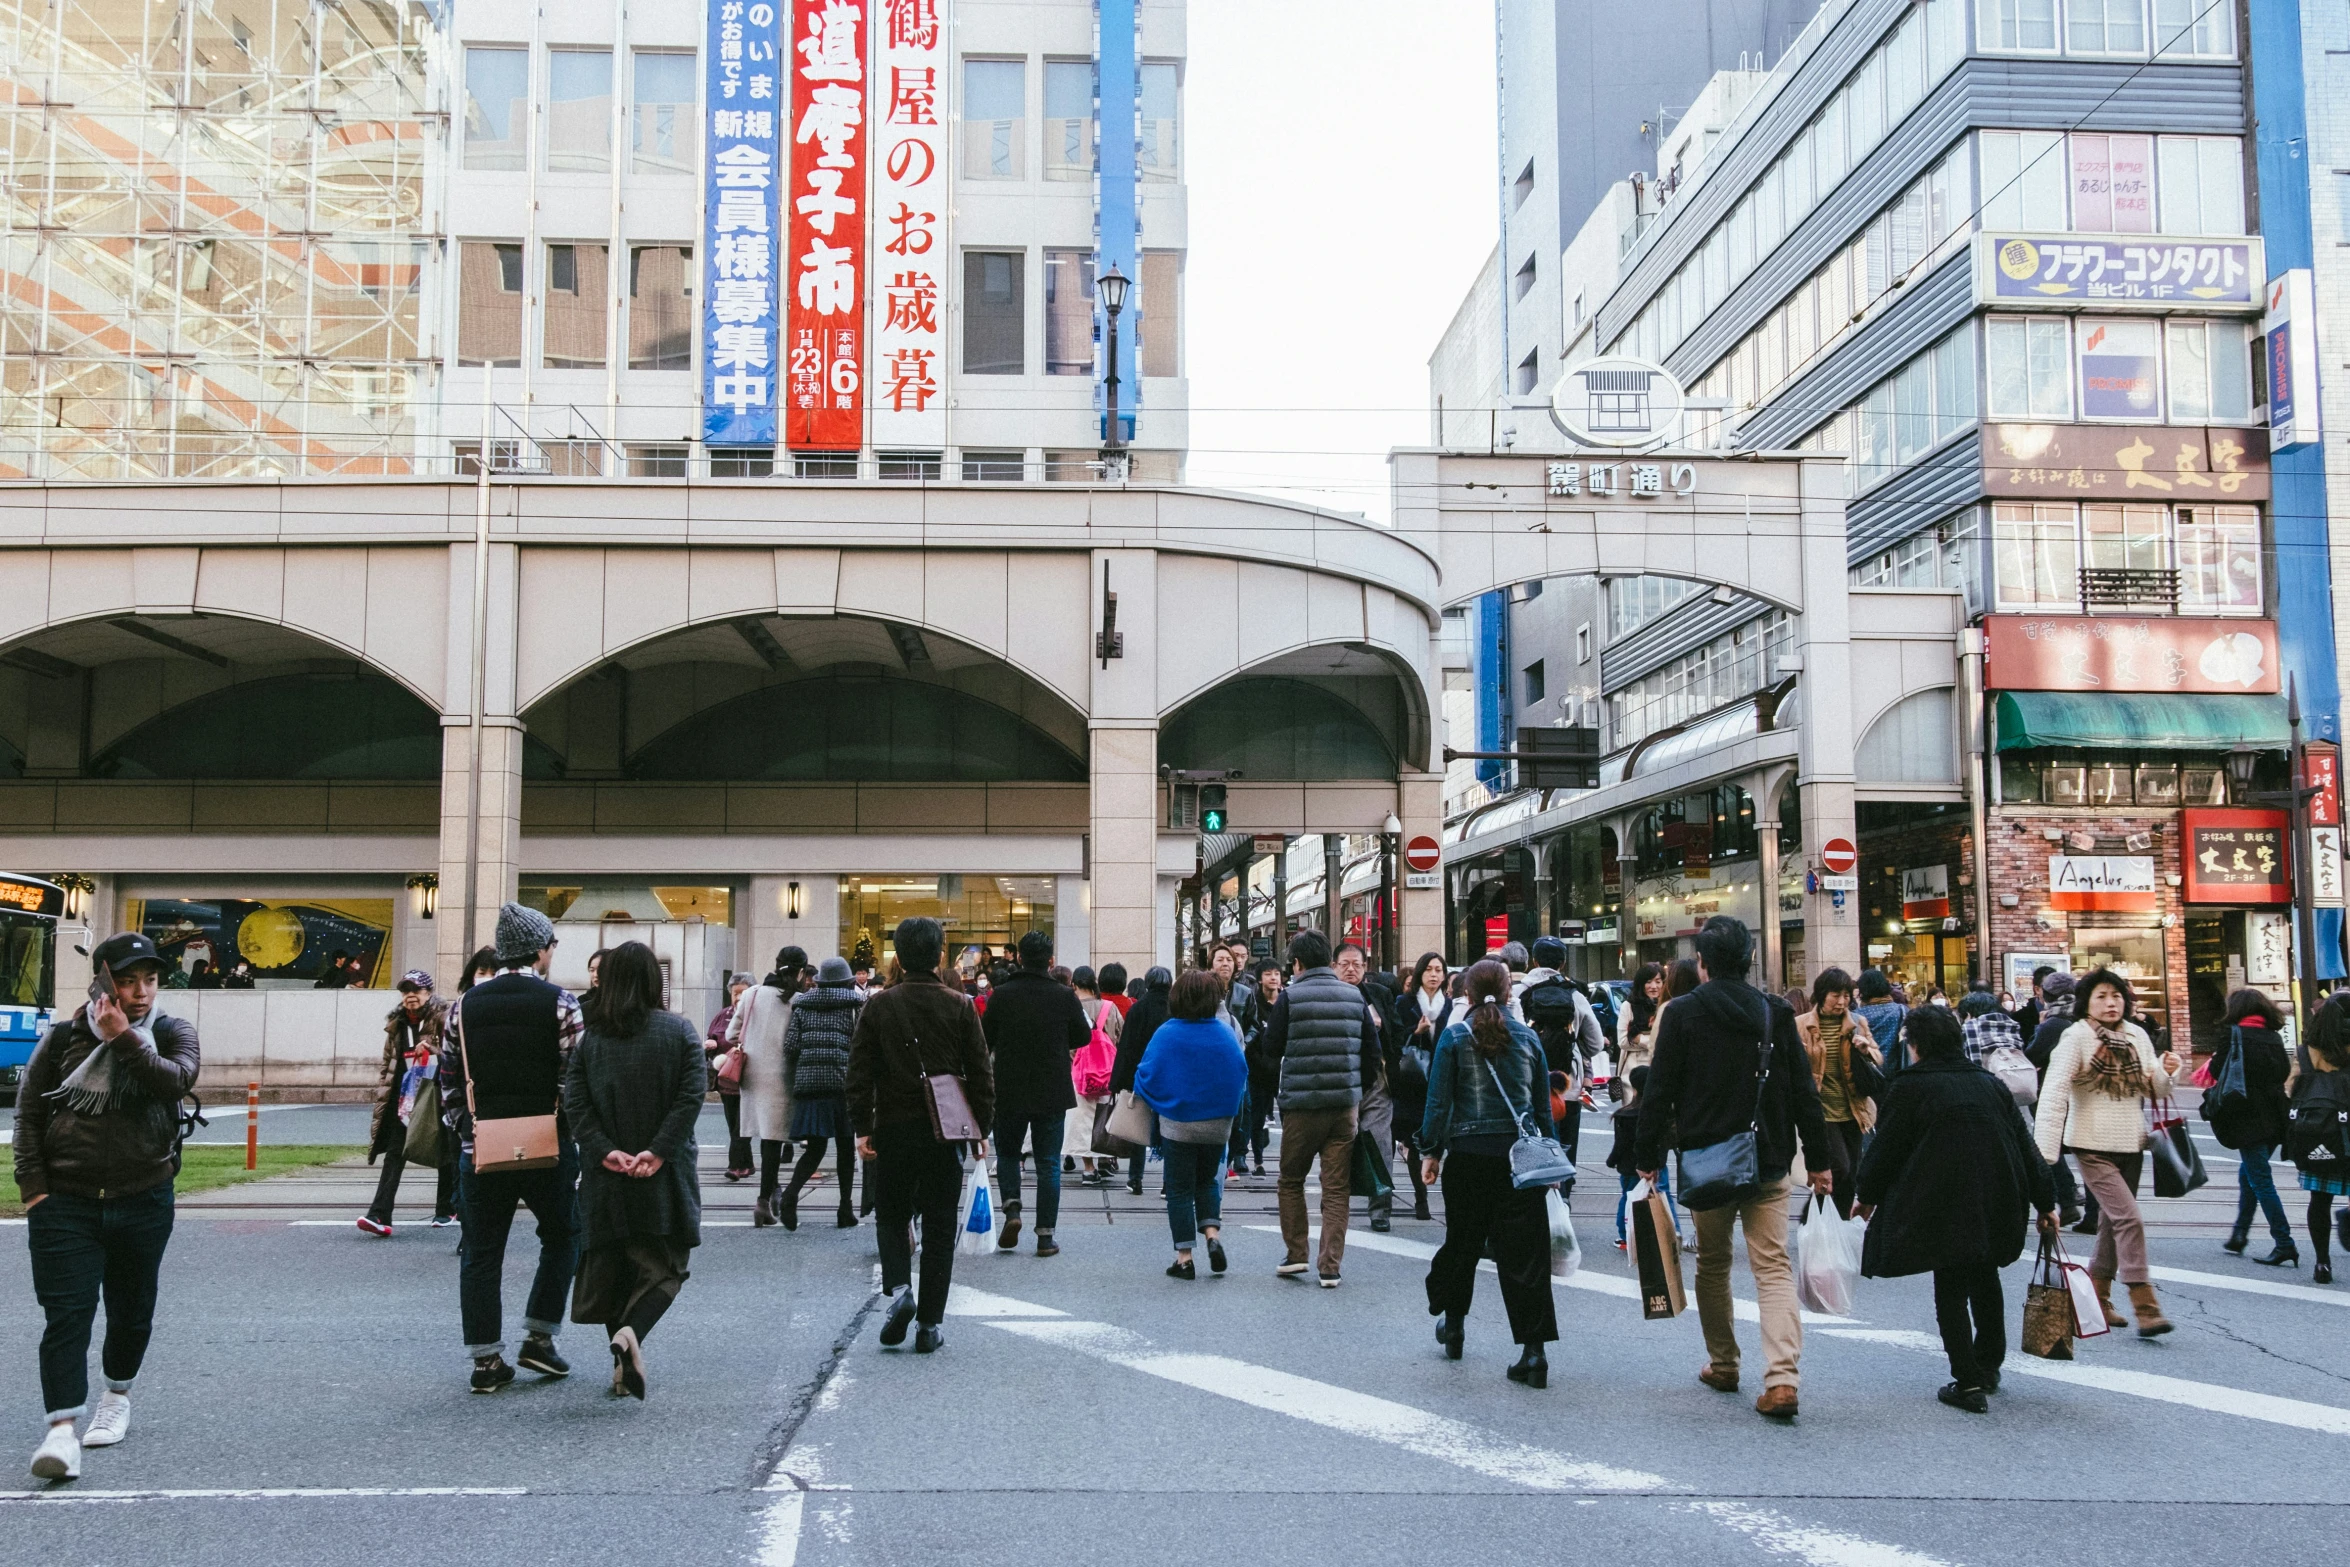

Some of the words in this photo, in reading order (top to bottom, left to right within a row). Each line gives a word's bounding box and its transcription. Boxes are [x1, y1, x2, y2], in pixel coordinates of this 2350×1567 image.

[720, 1, 744, 99] がお得です
[714, 109, 773, 139] 新規
[796, 0, 863, 316] 道産子市
[883, 0, 939, 413] 鶴屋のお歳暮
[712, 144, 771, 416] 会員様募集中
[2040, 245, 2245, 288] フラワーコンタクト
[2087, 282, 2146, 298] 当ビル
[2150, 284, 2174, 298] 1F
[2275, 331, 2288, 402] PROMISE
[2089, 376, 2150, 392] PROMISE
[2277, 425, 2291, 444] 4F
[1548, 463, 1697, 497] 駕町通り
[2058, 860, 2122, 890] Angelus
[2199, 845, 2277, 874] 大文字
[1650, 1295, 1667, 1305] ABC
